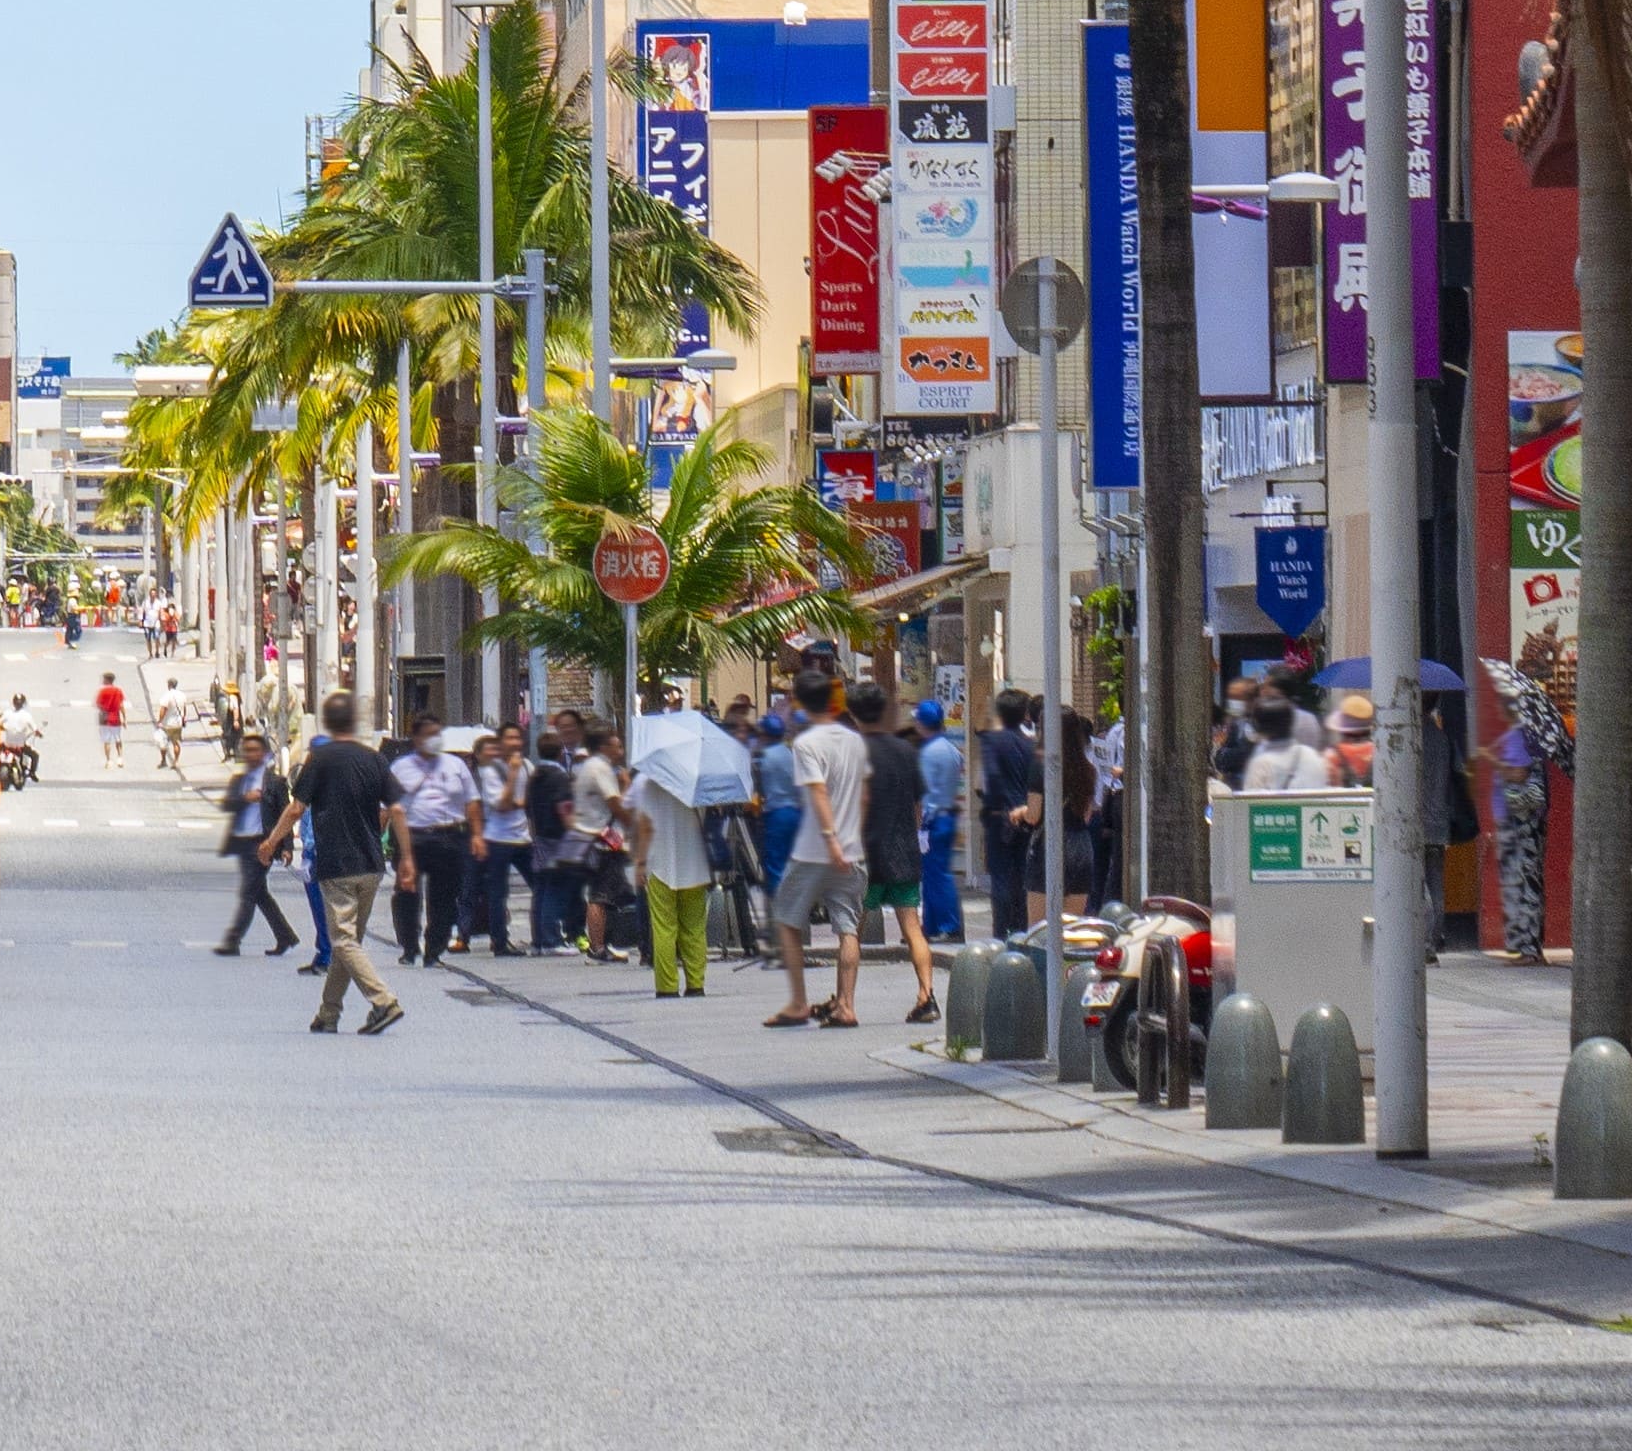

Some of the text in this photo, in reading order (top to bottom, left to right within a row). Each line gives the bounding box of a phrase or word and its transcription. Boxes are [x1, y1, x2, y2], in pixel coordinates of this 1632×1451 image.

[1117, 125, 1137, 205] HANDA
[1120, 210, 1139, 266] Watch
[820, 280, 863, 295] Sports
[820, 299, 857, 312] Darts
[1121, 272, 1141, 334] World
[820, 318, 865, 333] Dining
[919, 386, 973, 397] ESPRIT
[919, 398, 971, 409] COURT
[601, 550, 661, 578] 消火栓
[1270, 561, 1313, 572] HANDA
